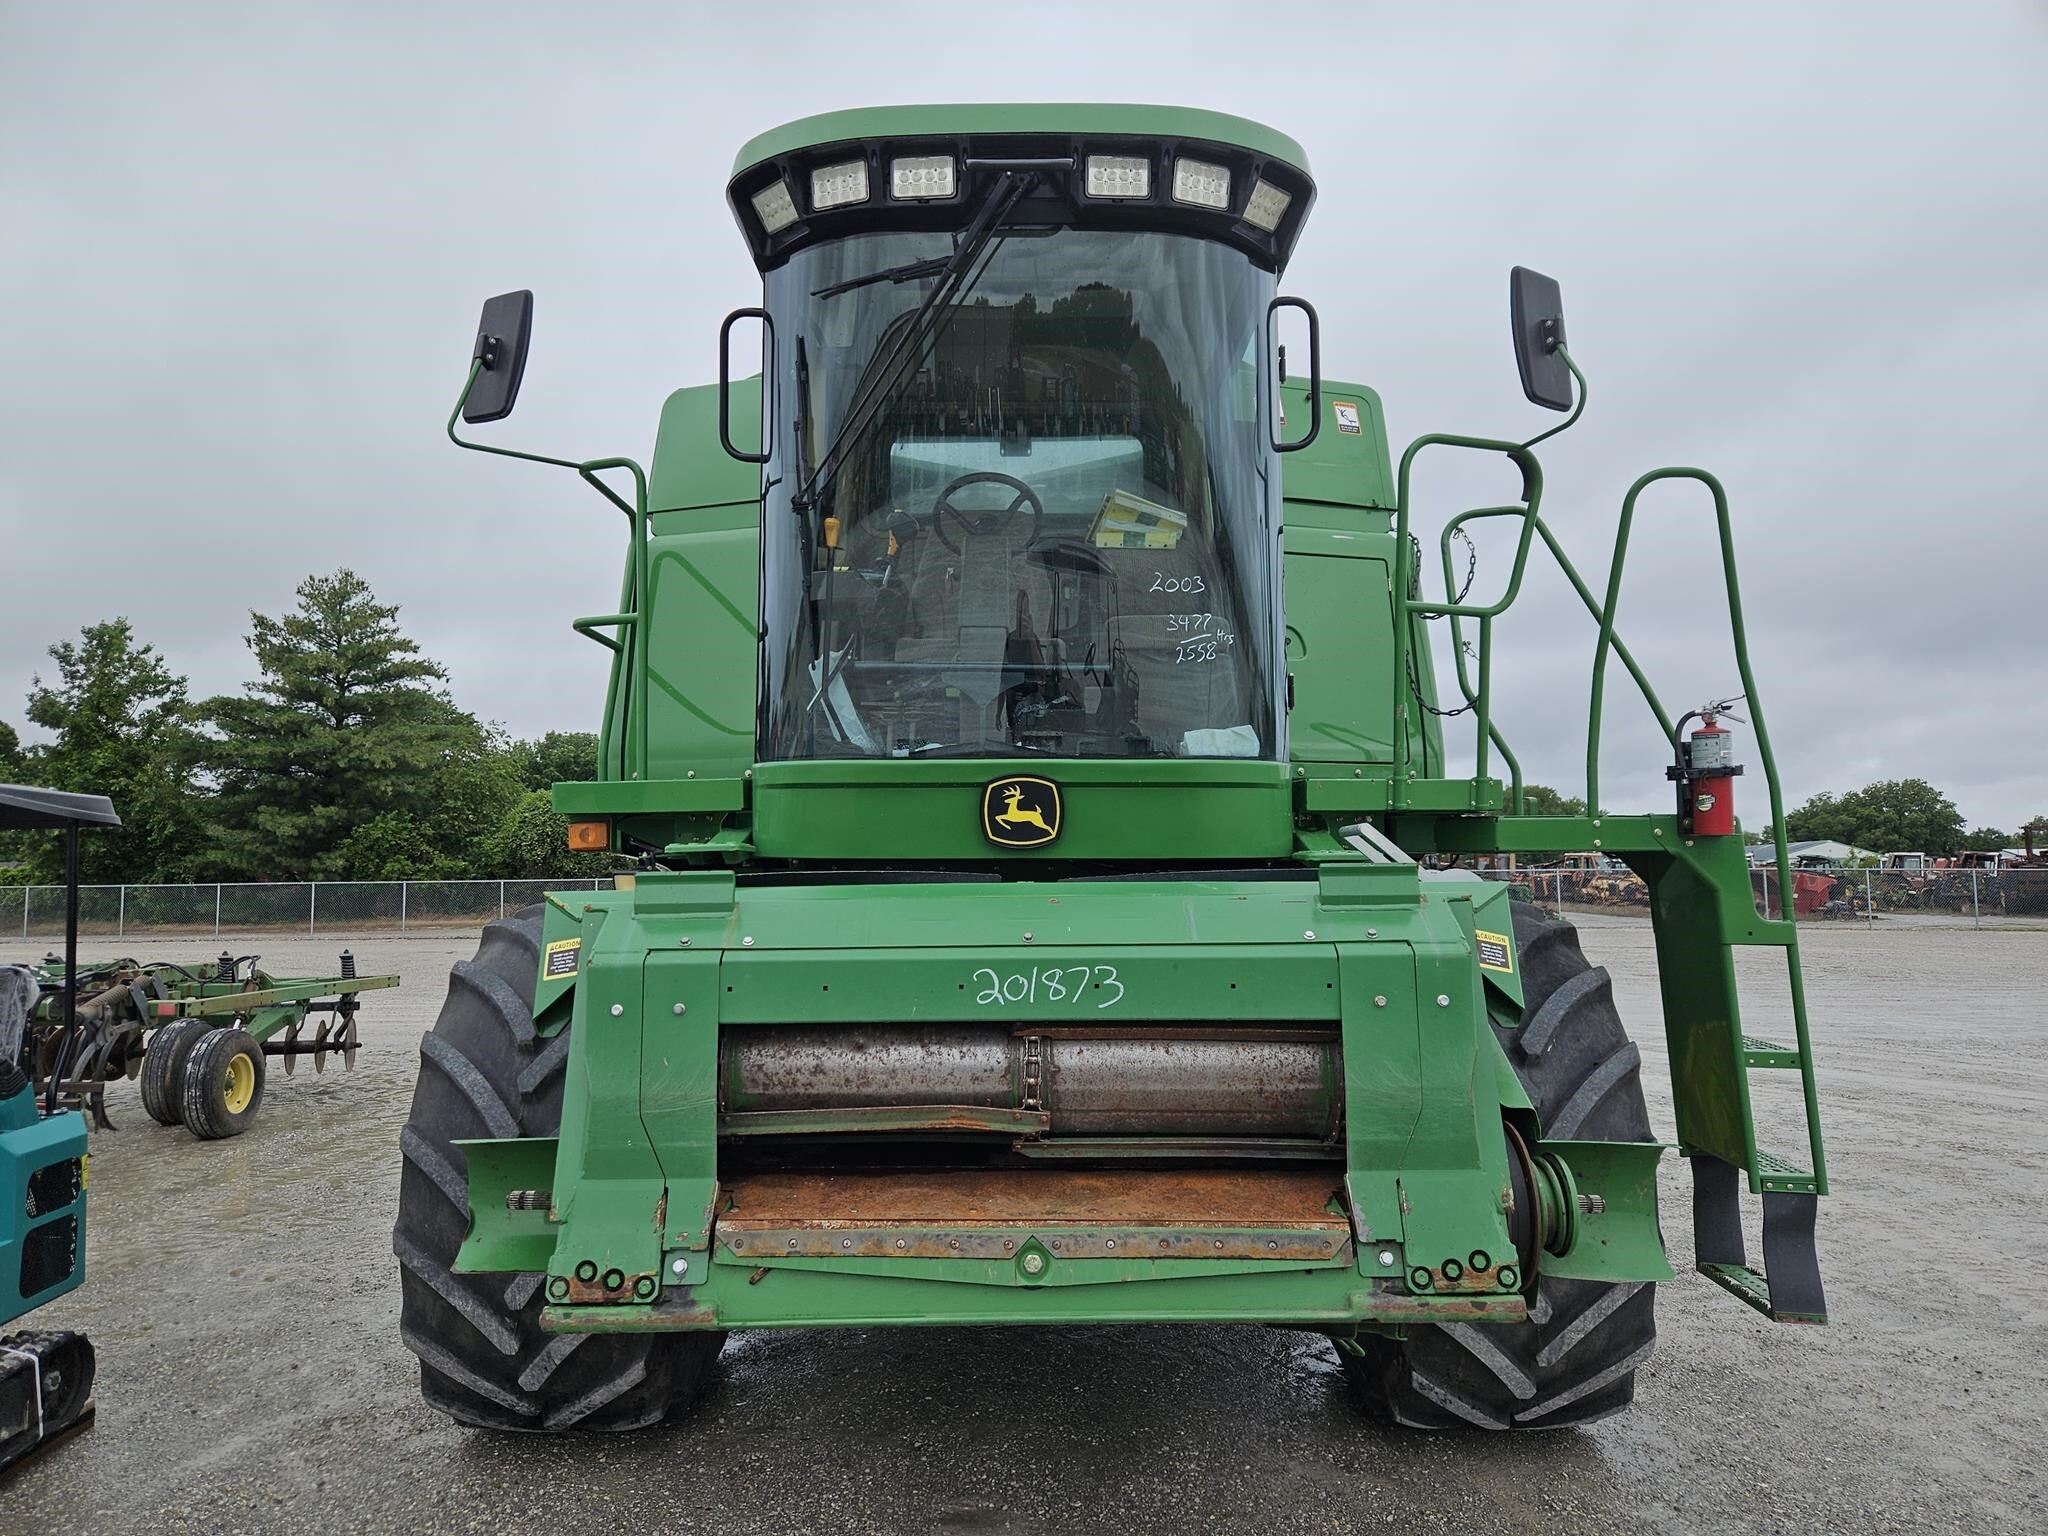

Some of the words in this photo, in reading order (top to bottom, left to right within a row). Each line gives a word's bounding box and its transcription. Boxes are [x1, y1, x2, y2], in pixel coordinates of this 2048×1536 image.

[1149, 571, 1205, 593] 2003
[1166, 613, 1212, 632] 3477
[1216, 629, 1235, 645] Hrs
[1175, 641, 1217, 664] 2558
[554, 940, 581, 950] CAUTION
[1480, 933, 1506, 943] CAUTION
[972, 966, 1125, 1009] 201873
